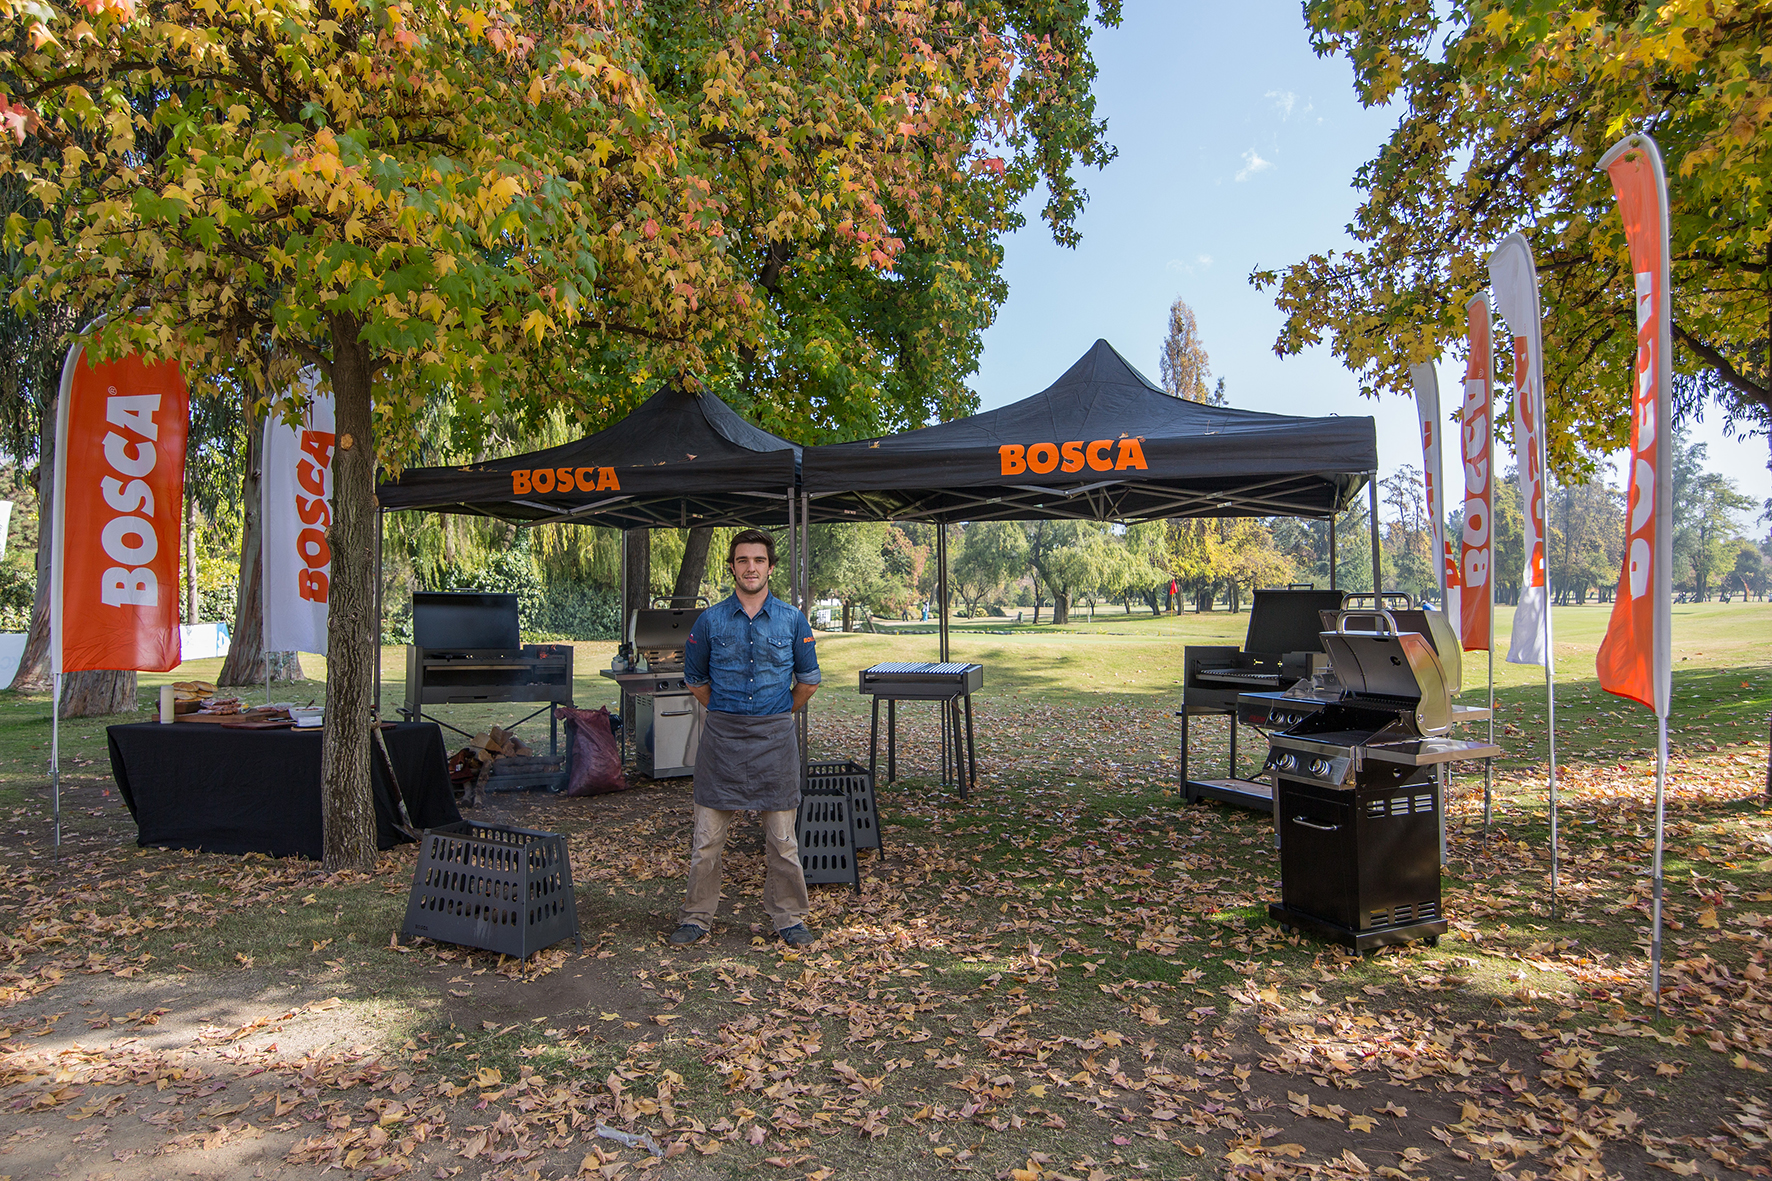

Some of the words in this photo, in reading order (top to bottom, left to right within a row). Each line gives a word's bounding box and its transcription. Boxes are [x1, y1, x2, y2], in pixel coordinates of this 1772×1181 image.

[100, 393, 162, 608] BOSCA
[511, 466, 621, 495] BOSCA
[998, 438, 1149, 476] BOSCA
[296, 430, 336, 604] BOSCA
